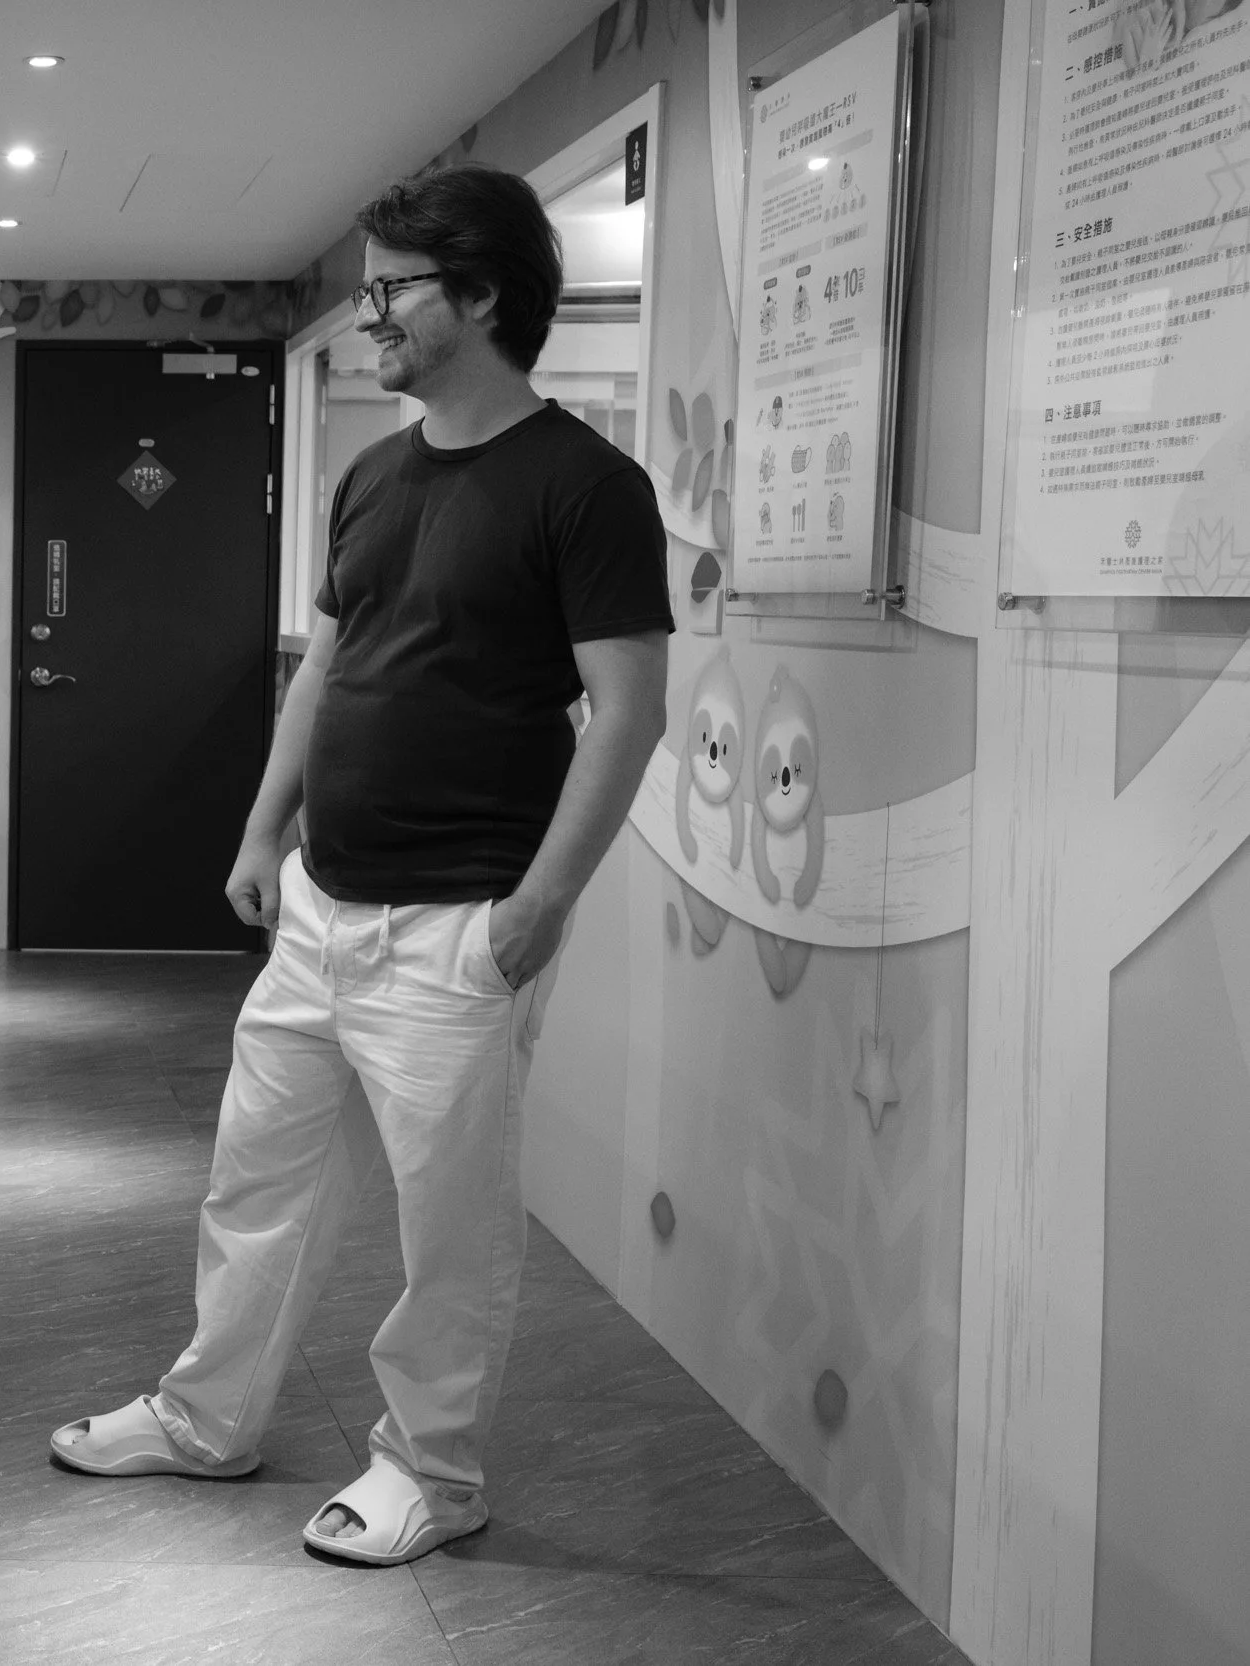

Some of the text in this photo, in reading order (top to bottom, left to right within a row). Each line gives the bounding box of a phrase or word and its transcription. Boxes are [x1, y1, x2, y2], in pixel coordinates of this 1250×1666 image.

[1065, 43, 1123, 81] 二、感控措施
[1055, 217, 1113, 248] 三、安全措施
[824, 276, 833, 304] 4
[842, 266, 859, 300] 10
[1044, 400, 1102, 422] 四、注意事項
